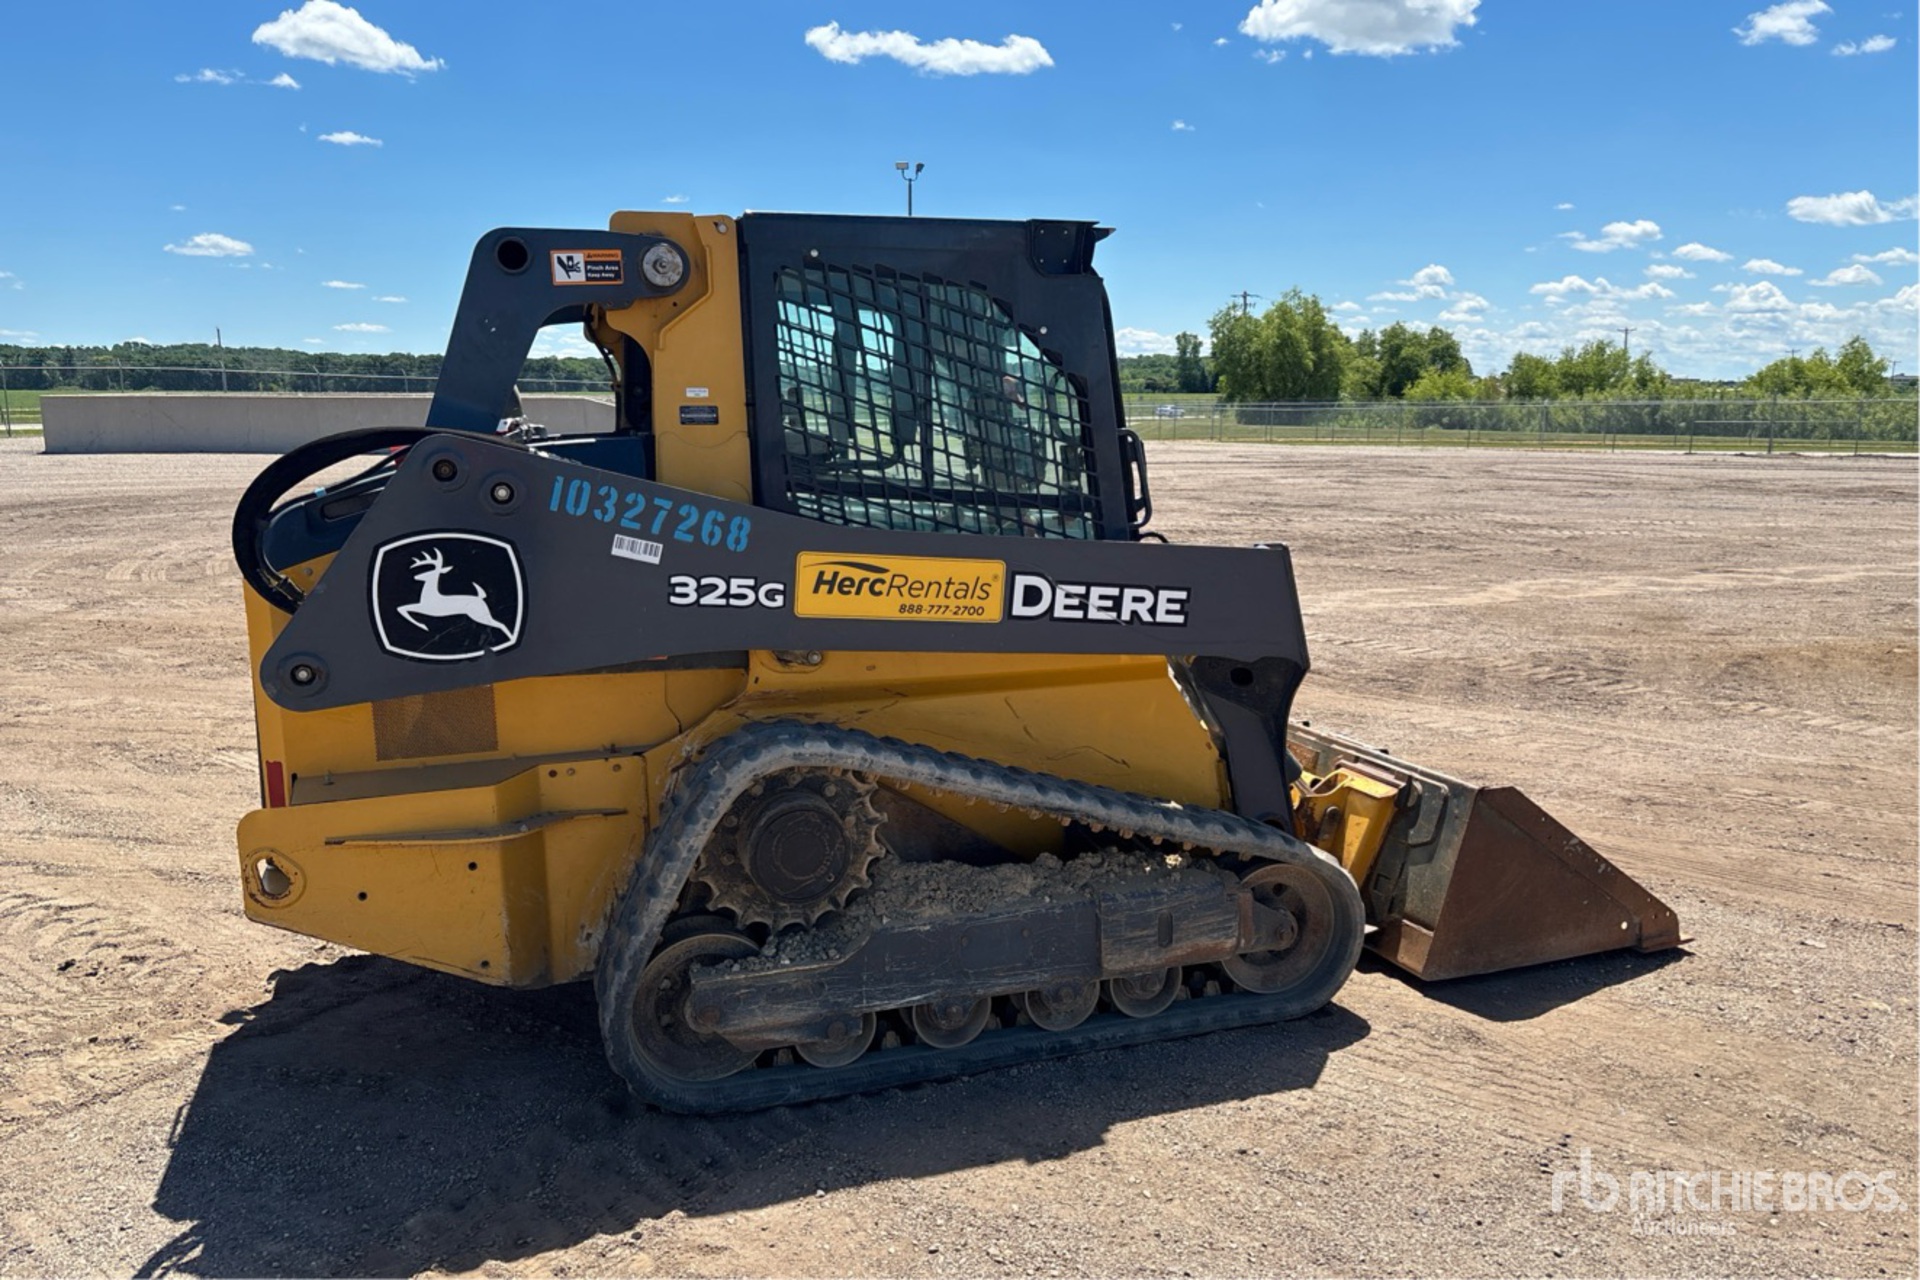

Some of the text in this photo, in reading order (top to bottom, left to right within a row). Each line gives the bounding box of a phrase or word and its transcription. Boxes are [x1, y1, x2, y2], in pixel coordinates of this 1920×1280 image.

[549, 475, 751, 553] 10327268
[668, 575, 786, 609] 325G
[898, 603, 985, 616] 888-777-2700
[1011, 574, 1188, 624] DEERE
